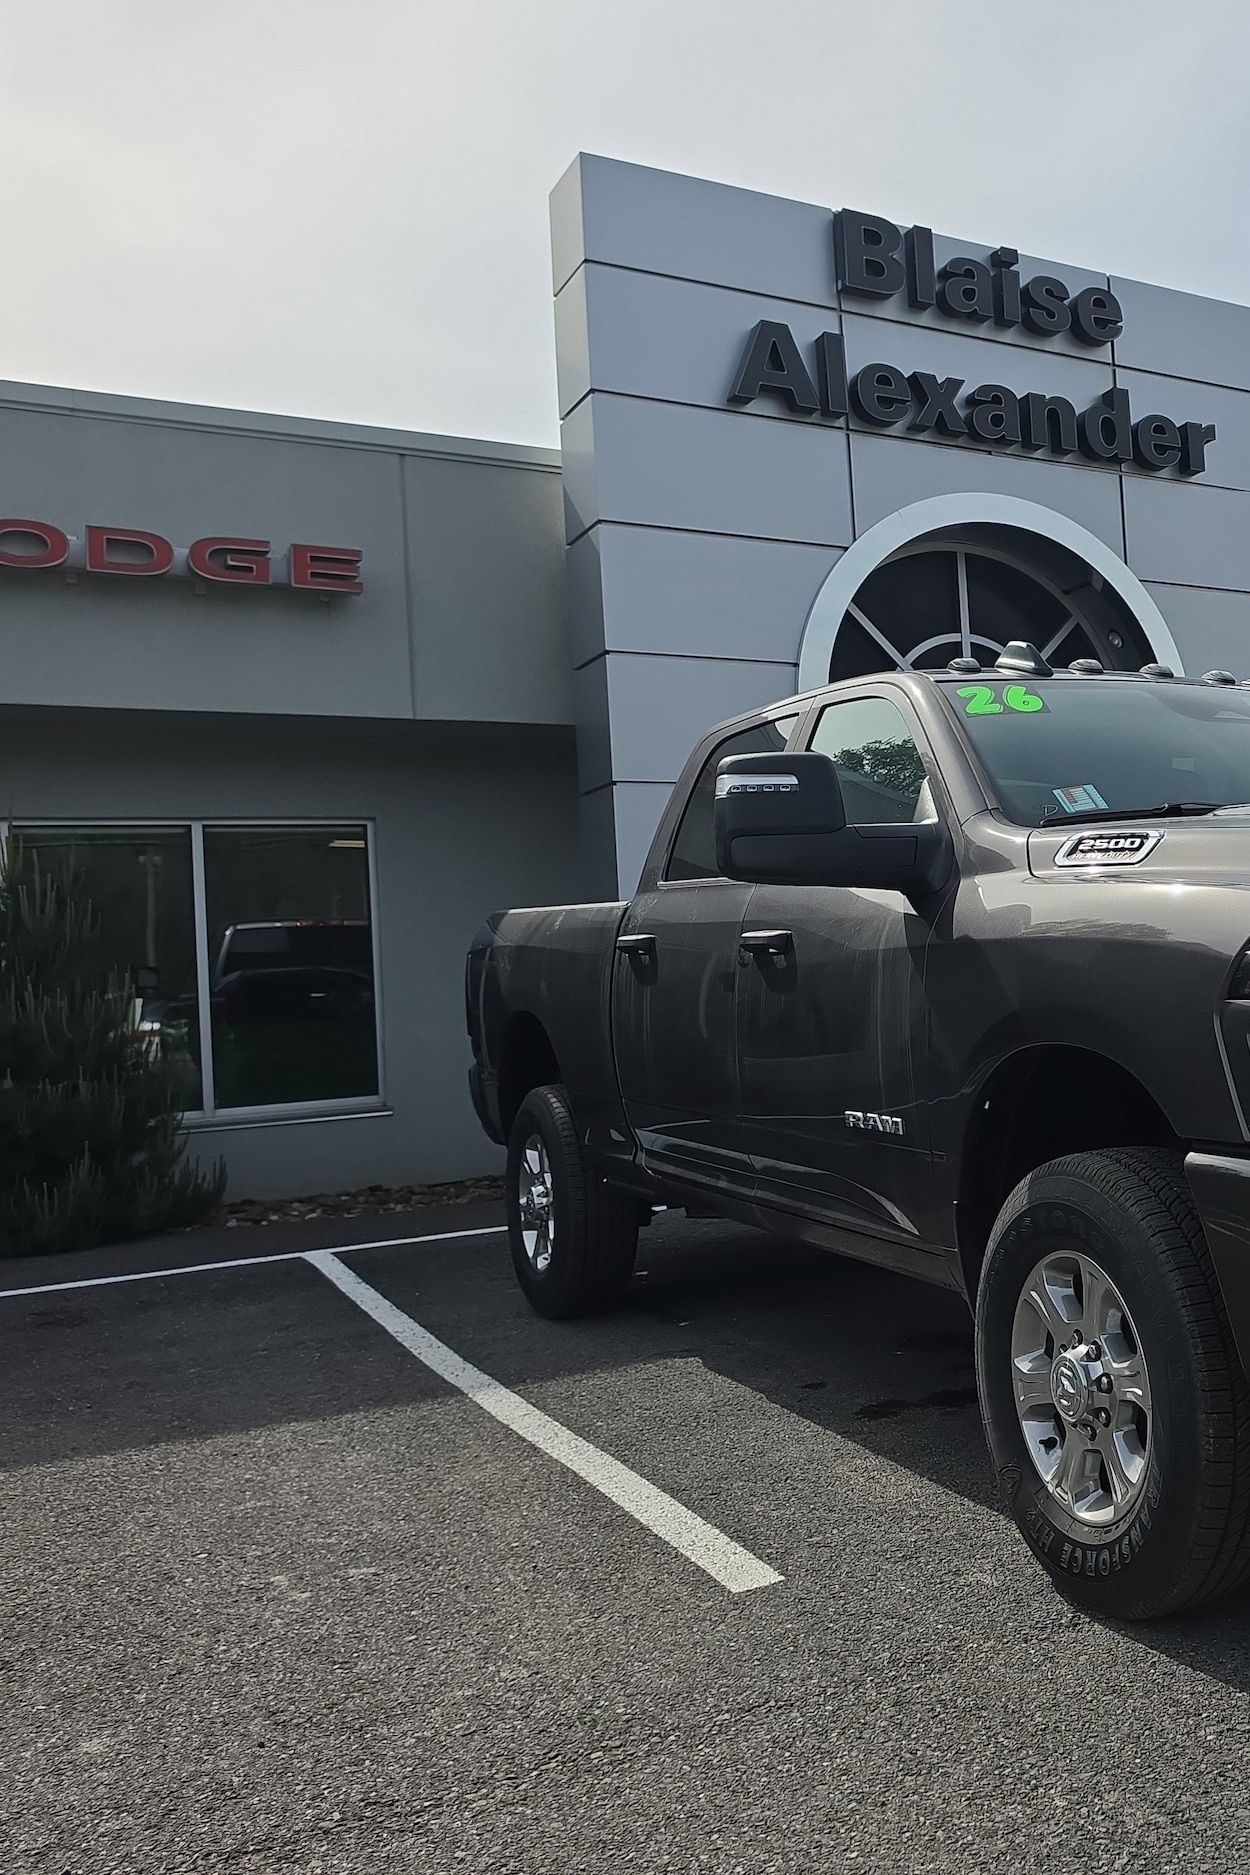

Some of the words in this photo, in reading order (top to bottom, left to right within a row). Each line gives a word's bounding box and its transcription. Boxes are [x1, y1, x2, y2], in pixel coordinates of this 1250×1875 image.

[834, 208, 1124, 347] Blaise
[728, 319, 1216, 477] Alexander
[956, 684, 1044, 715] 26
[1079, 838, 1142, 849] 2500
[844, 1110, 905, 1135] RAM
[988, 1208, 1105, 1289] Frestone
[1059, 1462, 1164, 1577] TRANSFORCE
